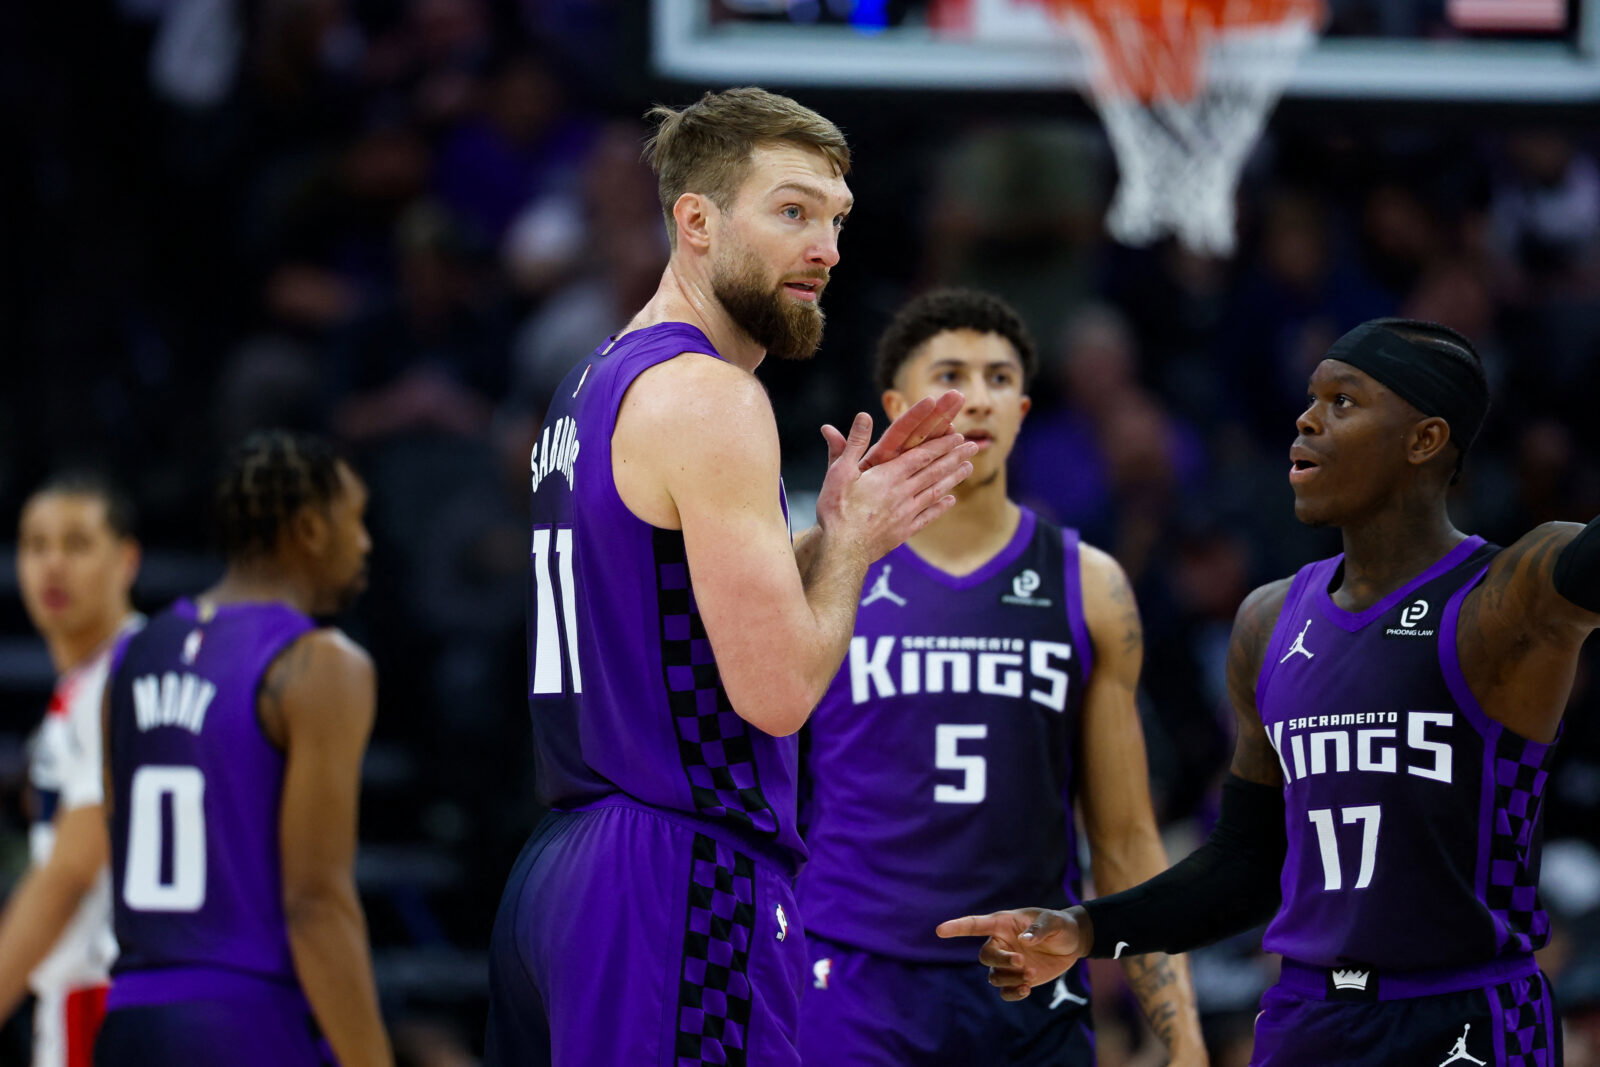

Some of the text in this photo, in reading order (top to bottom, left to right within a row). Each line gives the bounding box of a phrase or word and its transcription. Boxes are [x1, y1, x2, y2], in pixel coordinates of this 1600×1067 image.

[532, 528, 582, 694] 11
[902, 636, 1025, 652] SACRAMENTO
[1289, 712, 1398, 730] SACRAMENTO
[934, 724, 988, 804] 5
[123, 766, 207, 912] 0
[1308, 805, 1381, 891] 17
